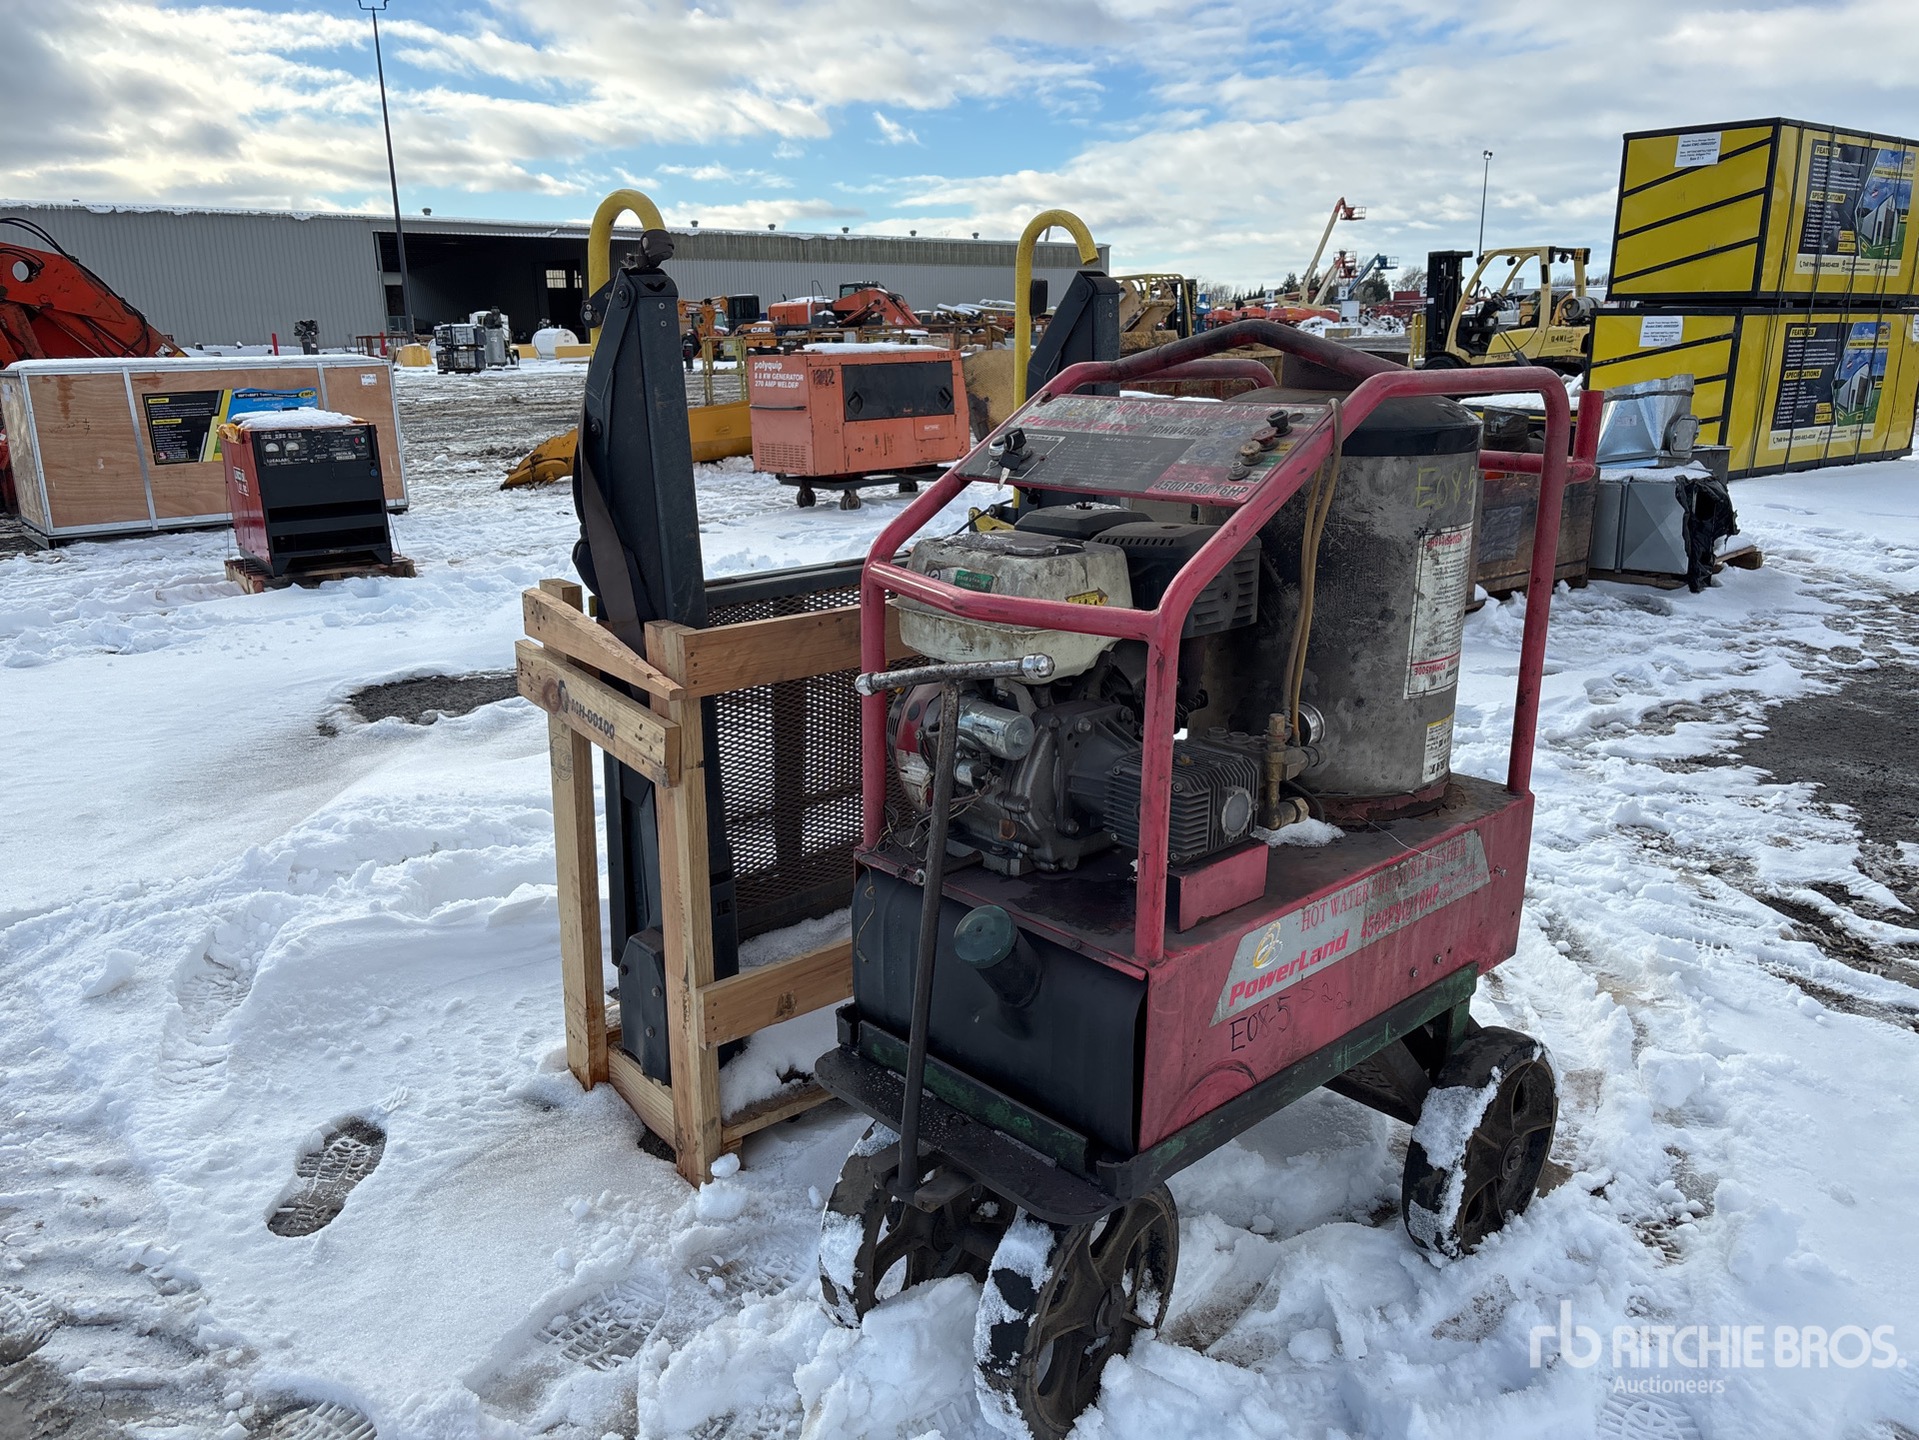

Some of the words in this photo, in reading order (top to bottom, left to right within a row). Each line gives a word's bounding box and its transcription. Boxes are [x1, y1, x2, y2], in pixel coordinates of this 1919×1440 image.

[754, 360, 782, 372] polyquip
[771, 373, 804, 381] GENERATOR
[1301, 902, 1328, 932] HOT
[1330, 882, 1370, 918] WATER
[1228, 928, 1350, 1008] PowerLand
